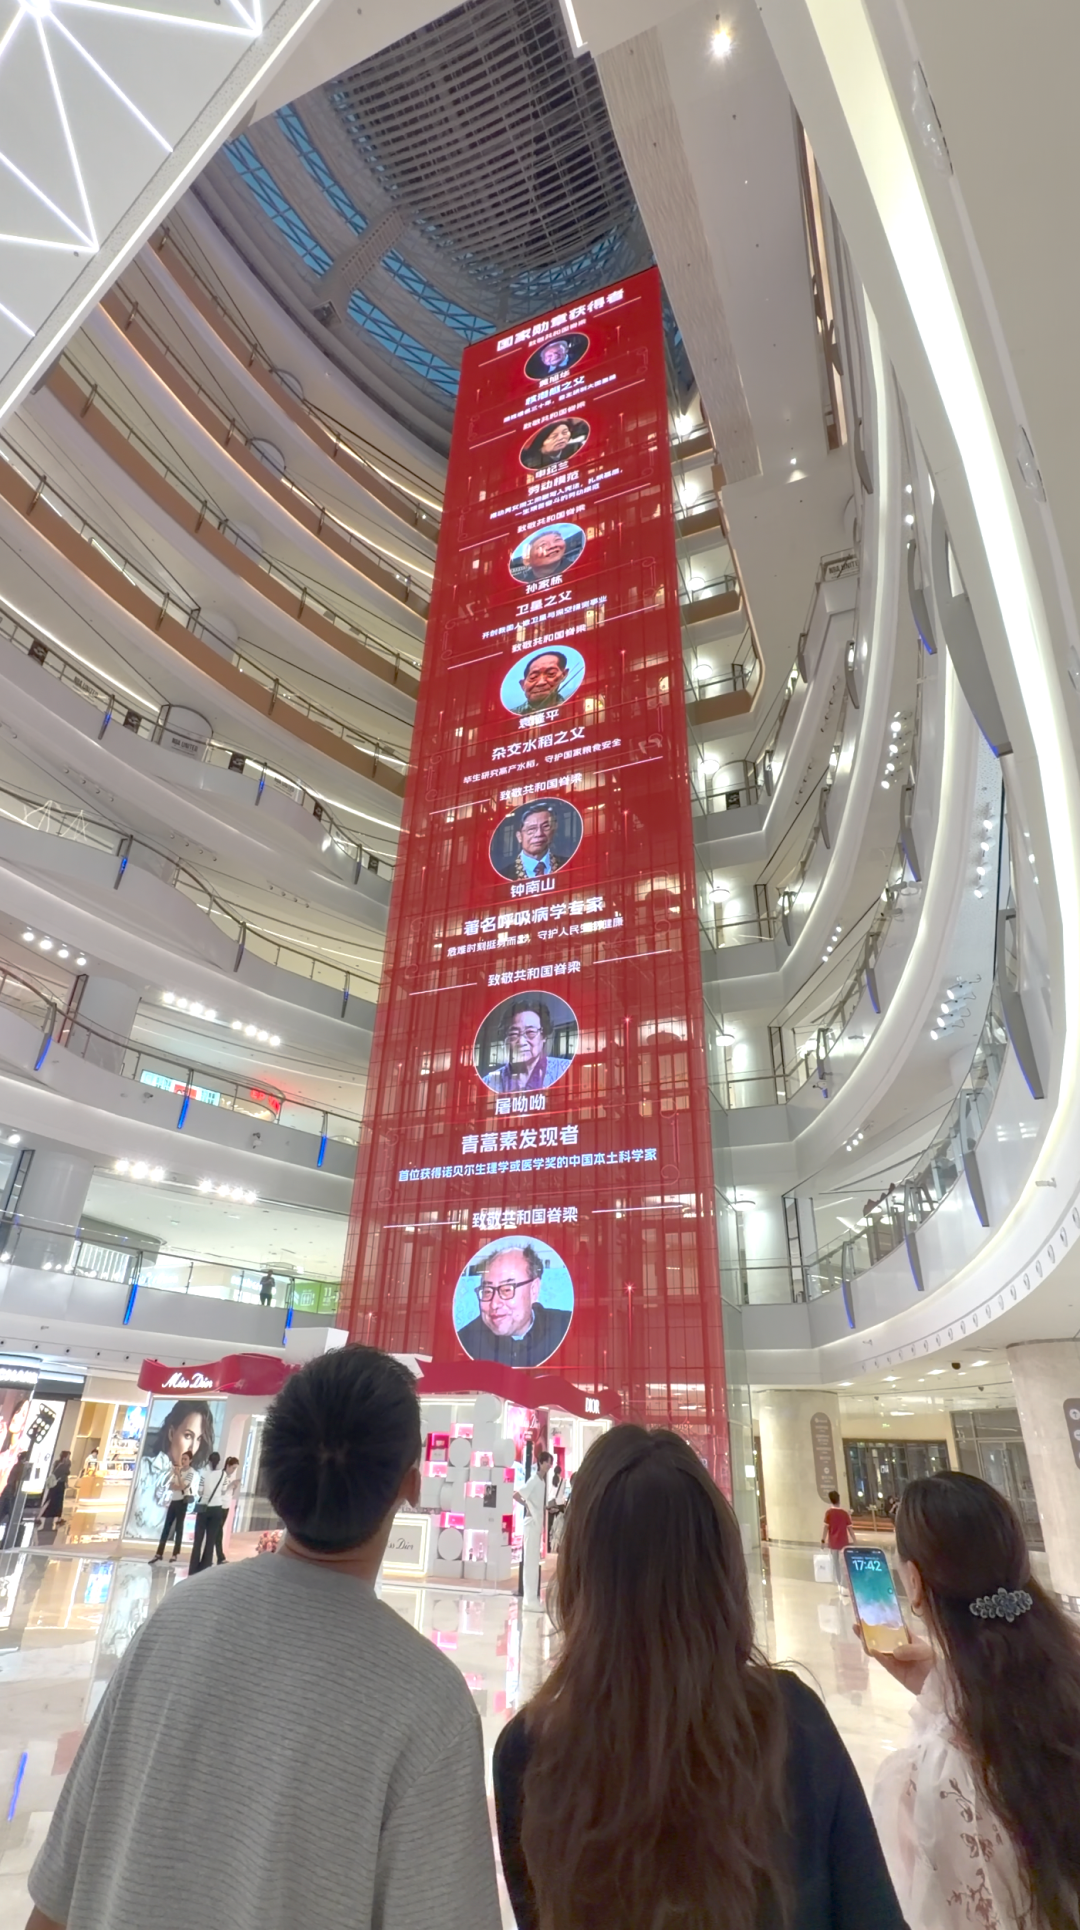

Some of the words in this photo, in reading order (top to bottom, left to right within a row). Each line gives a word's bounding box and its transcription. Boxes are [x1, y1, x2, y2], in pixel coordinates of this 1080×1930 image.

[496, 288, 625, 352] 国家勋章获得者
[535, 460, 569, 478] 申纪兰
[528, 470, 580, 496] 劳动模范
[517, 503, 586, 533] 致敬共和国脊梁
[525, 575, 563, 594] 孙家栋
[515, 590, 572, 617] 卫星之父
[511, 624, 587, 653] 致敬共和国脊梁
[518, 708, 560, 729] 袁隆平
[491, 726, 586, 761] 杂交水稻之父
[499, 772, 583, 801] 致敬共和国脊梁
[510, 877, 556, 898] 钟南山
[463, 895, 605, 937] 著名呼吸病学专家
[487, 960, 581, 988] 致敬共和国脊梁
[494, 1093, 546, 1116] 屠呦呦
[461, 1124, 579, 1155] 青蒿素发现者
[398, 1147, 658, 1182] 首位获得诺贝尔生理学或医学奖的中国本土科学家
[472, 1207, 579, 1229] 致敬共和国脊梁
[161, 1372, 190, 1388] Miss
[189, 1372, 213, 1388] Dior
[584, 1397, 600, 1414] DIOR
[395, 1537, 414, 1550] Dior
[852, 1560, 883, 1571] 17:42
